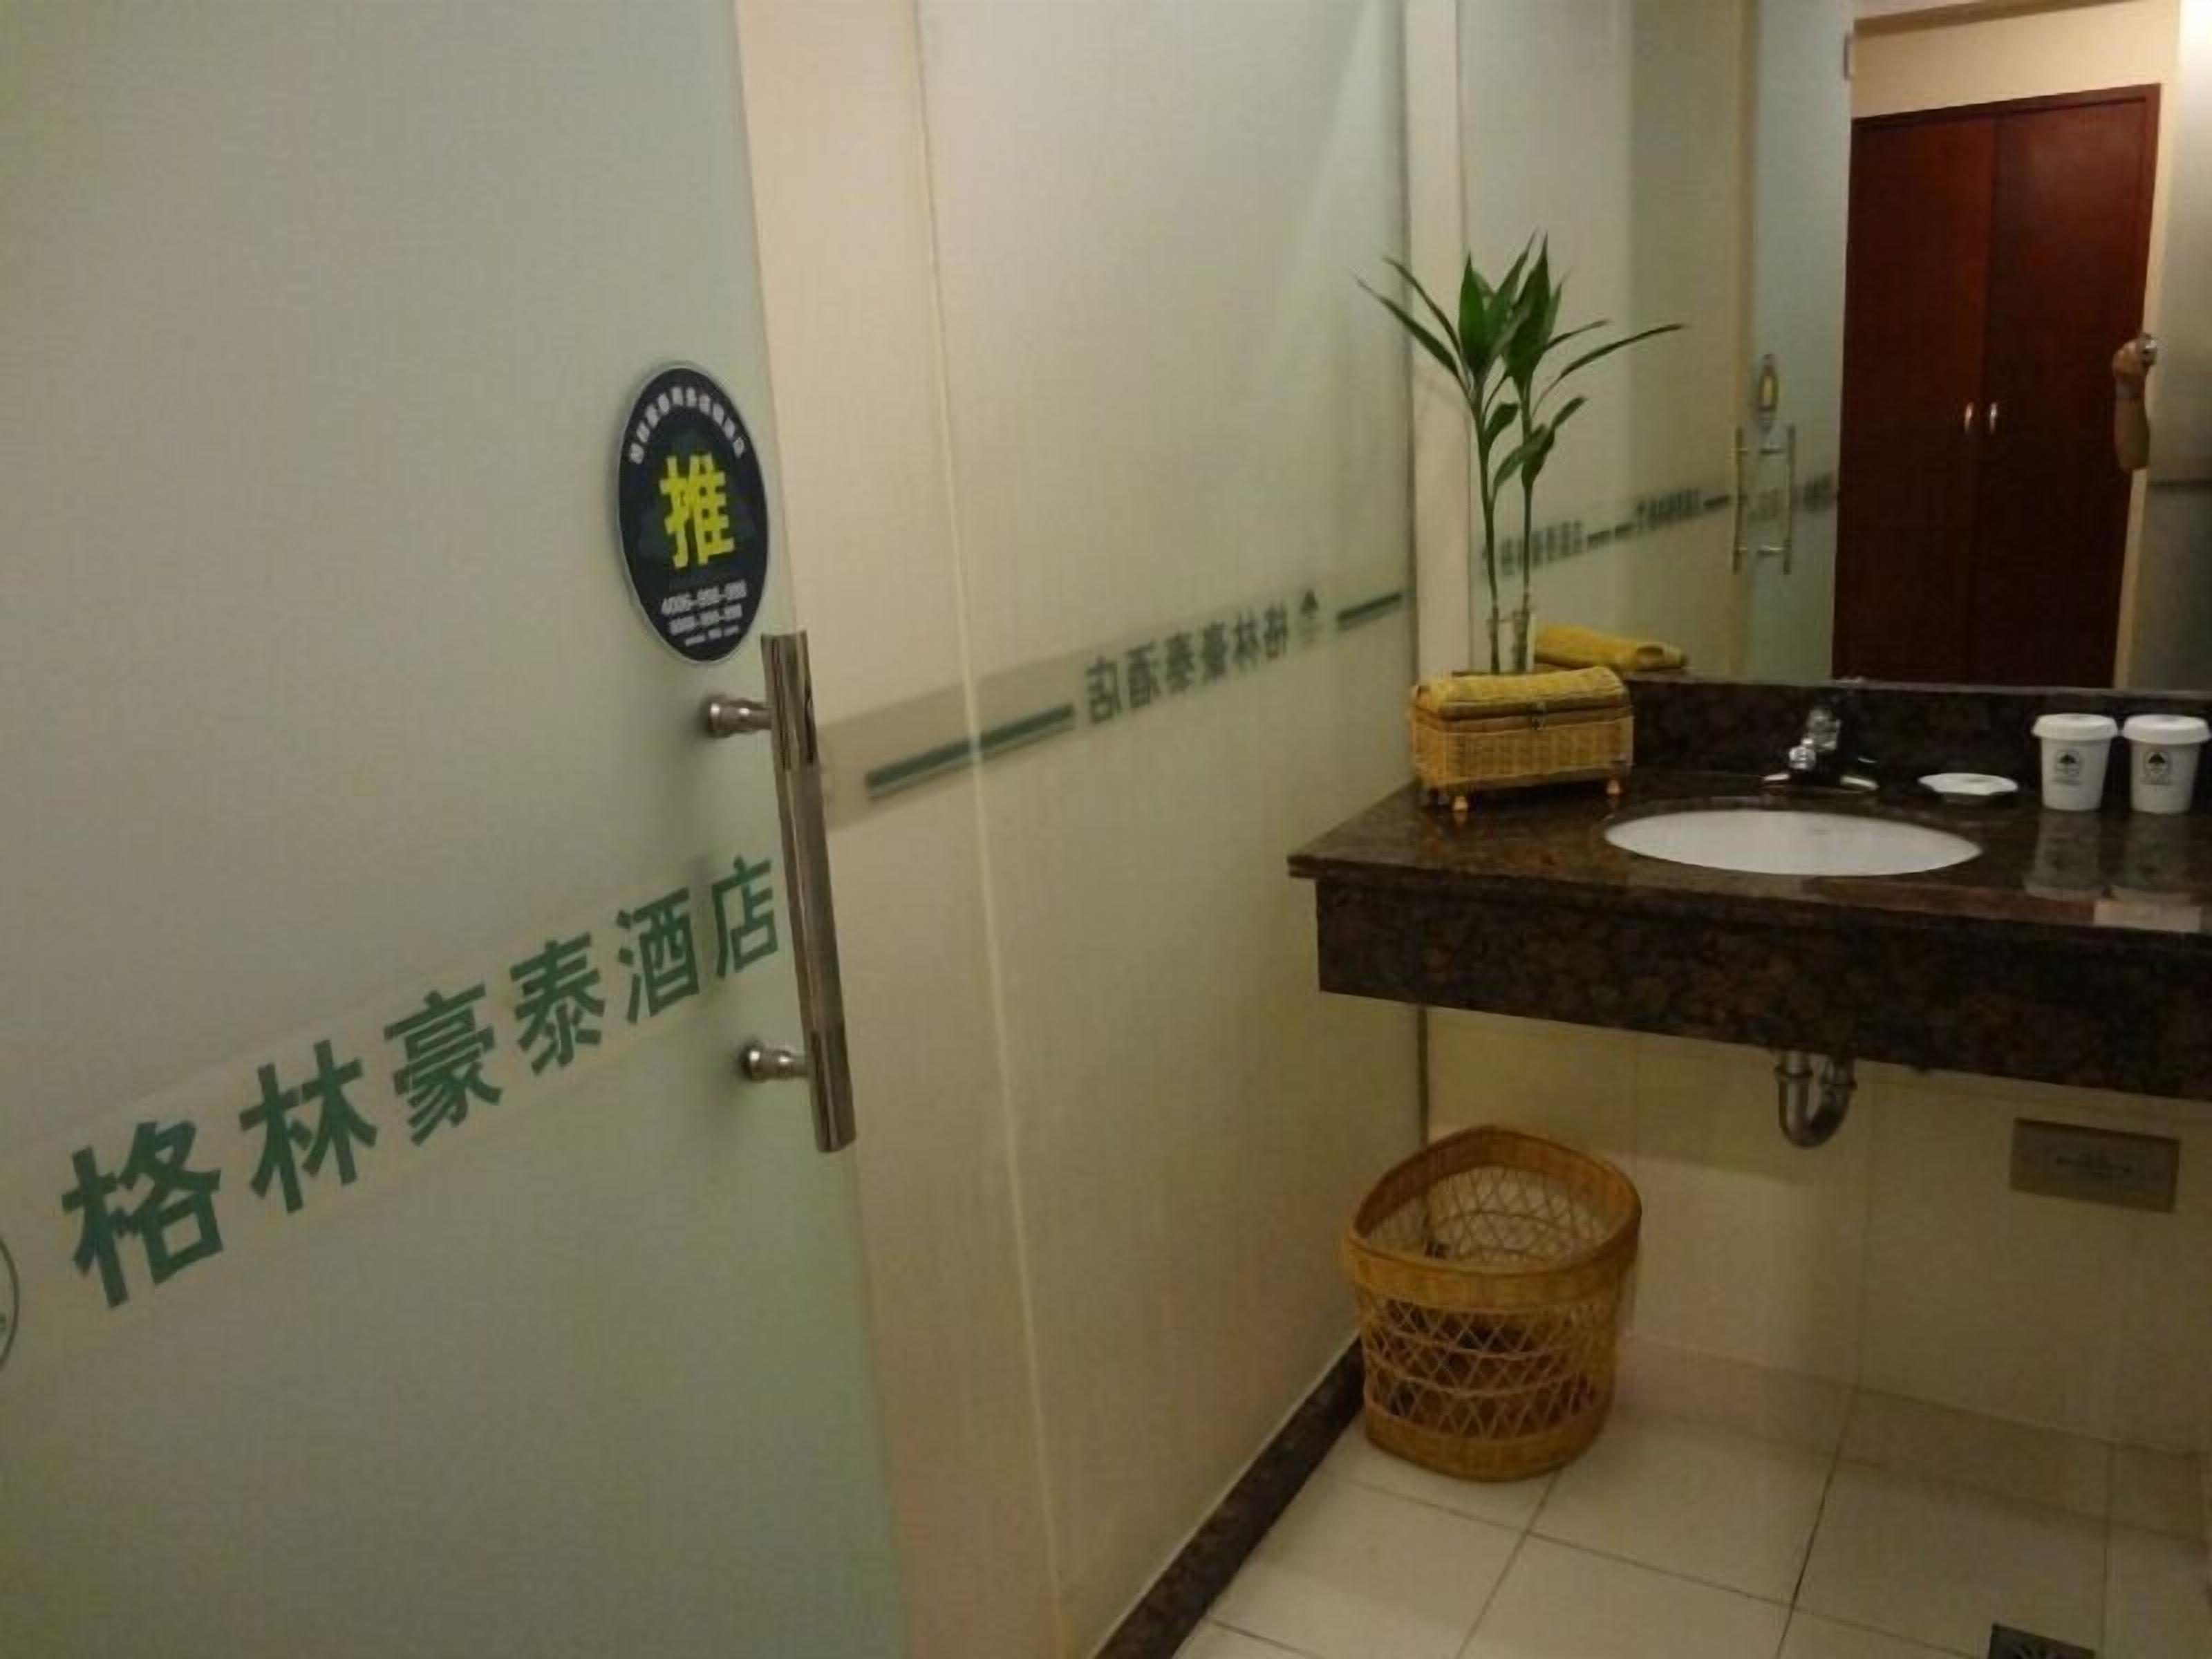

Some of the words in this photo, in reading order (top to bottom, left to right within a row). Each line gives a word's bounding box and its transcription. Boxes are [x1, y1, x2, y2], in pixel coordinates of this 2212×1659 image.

[659, 451, 735, 569] 推
[61, 855, 779, 1309] 格林豪泰酒店
